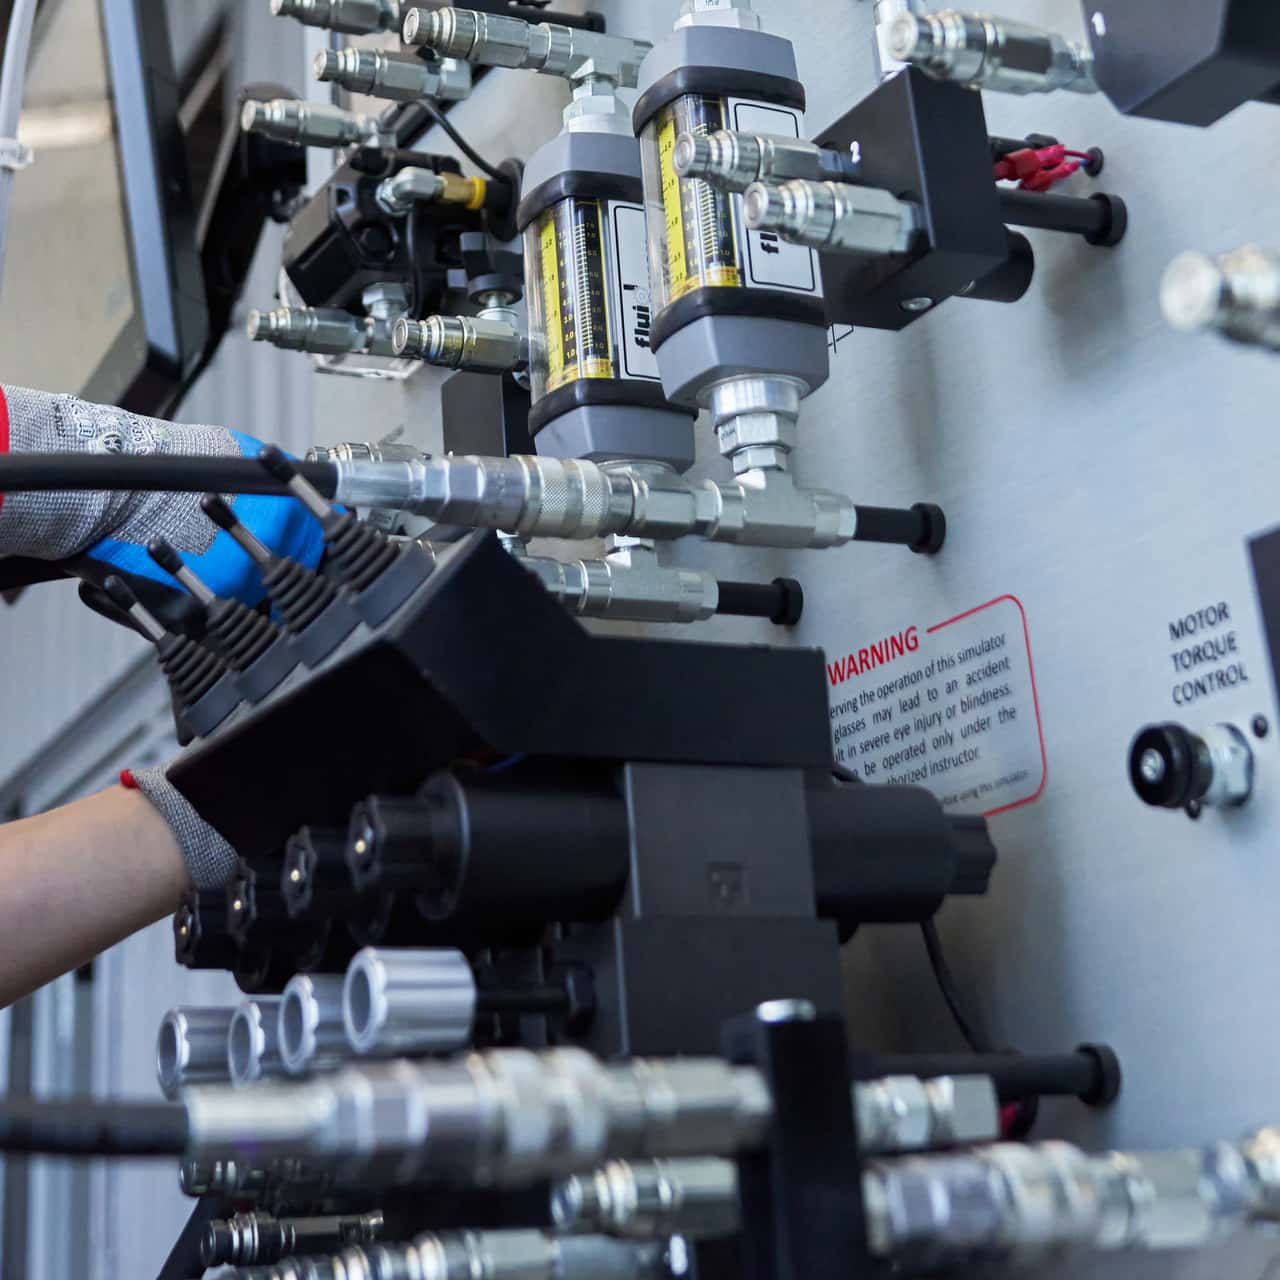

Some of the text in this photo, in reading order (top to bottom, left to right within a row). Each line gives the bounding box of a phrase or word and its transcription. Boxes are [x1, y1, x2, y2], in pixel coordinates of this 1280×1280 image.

[1092, 11, 1106, 36] 1
[1168, 601, 1230, 641] MOTOR
[827, 625, 919, 686] WARNING
[830, 633, 1007, 718] erving the operation of this simulator
[1171, 631, 1237, 672] TORQUE
[833, 656, 1011, 744] glasses may lead to an accident
[1172, 662, 1249, 705] CONTROL
[847, 742, 857, 759] in
[859, 731, 891, 754] severe
[893, 723, 912, 741] eye
[913, 710, 942, 733] injury
[945, 704, 957, 720] or
[864, 760, 877, 777] be
[882, 737, 927, 770] operated
[932, 728, 954, 751] only
[960, 715, 992, 740] under
[998, 706, 1017, 725] the
